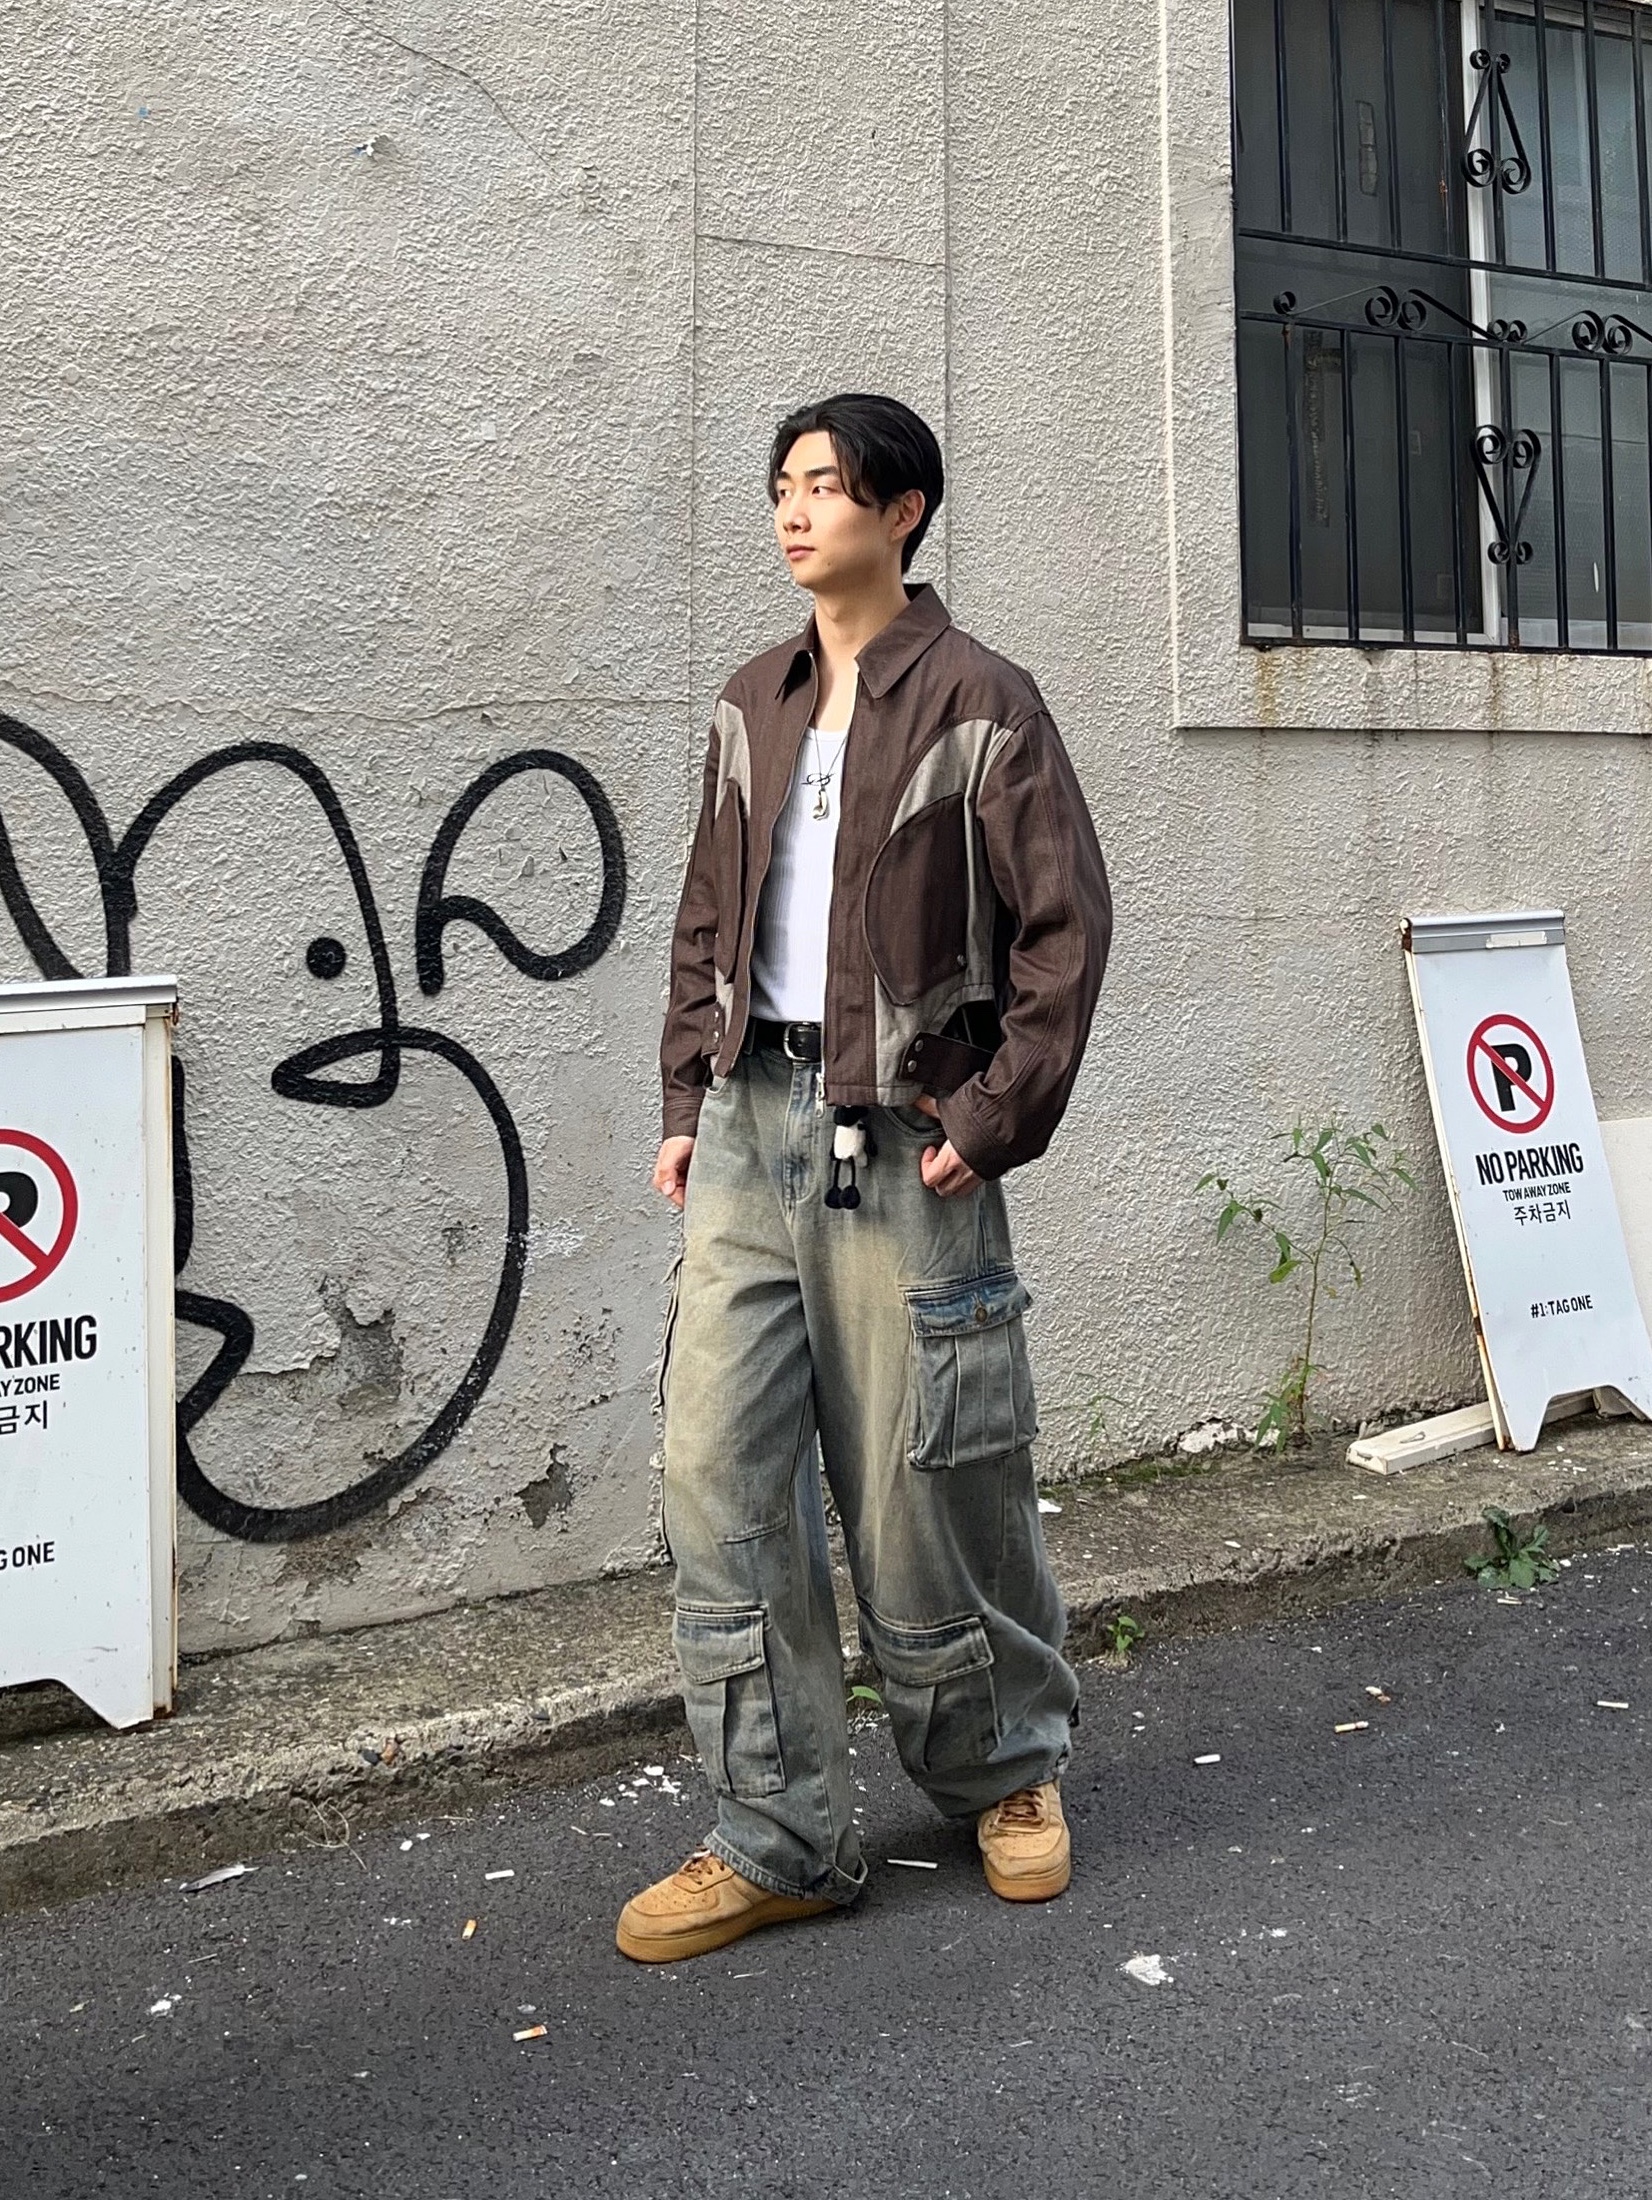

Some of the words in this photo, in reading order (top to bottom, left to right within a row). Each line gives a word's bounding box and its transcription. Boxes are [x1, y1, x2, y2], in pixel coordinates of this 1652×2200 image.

[1475, 1152, 1505, 1185] NO
[1504, 1142, 1584, 1181] PARKING
[1502, 1187, 1522, 1201] TOW
[1523, 1184, 1546, 1199] AWAY
[1547, 1181, 1571, 1196] ZONE
[1513, 1199, 1571, 1226] 주차금지
[1570, 1294, 1593, 1312] ONE
[14, 1373, 60, 1396] ZONE
[0, 1399, 48, 1435] 금지
[12, 1540, 55, 1568] ONE
